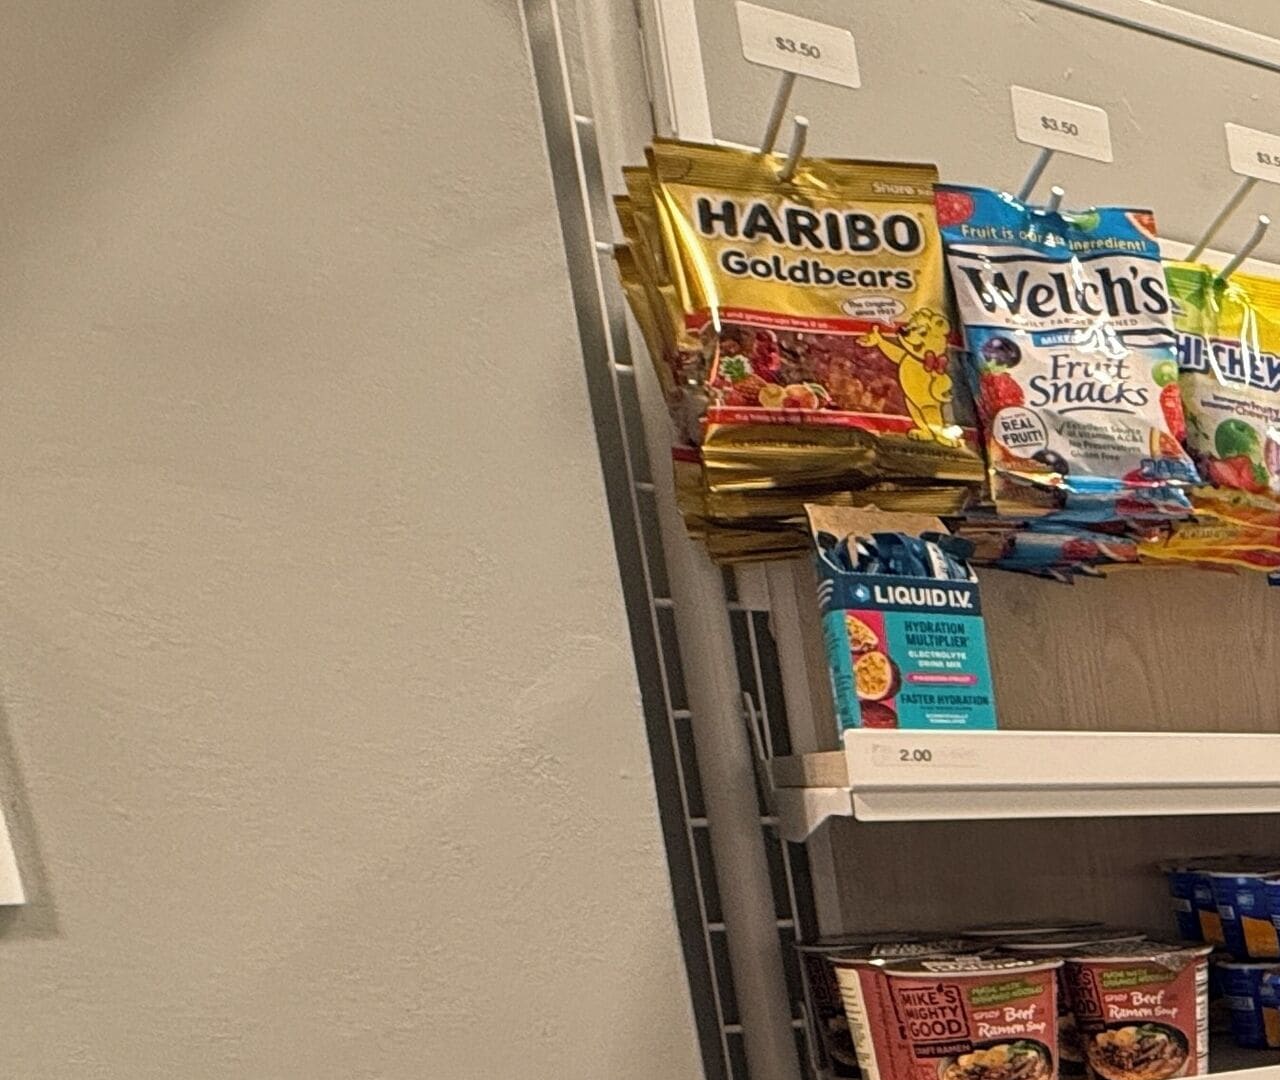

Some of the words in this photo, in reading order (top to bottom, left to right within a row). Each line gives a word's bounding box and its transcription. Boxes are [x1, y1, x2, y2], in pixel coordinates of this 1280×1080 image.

[775, 36, 820, 59] $3.50
[1041, 116, 1078, 136] $3.50
[697, 198, 922, 253] HARIBO
[961, 224, 997, 239] Fruit
[1002, 226, 1014, 239] is
[721, 250, 913, 290] Goldbears
[958, 265, 1167, 317] Welch's
[1051, 354, 1129, 381] Fruit
[1030, 376, 1148, 407] Snacks
[1001, 418, 1034, 432] REAL
[1002, 430, 1042, 446] FRUIT!
[874, 585, 950, 605] LIQUID
[905, 620, 966, 635] HYDRATION
[906, 634, 968, 648] MULTIPLIER
[900, 694, 935, 705] FASTER
[900, 749, 932, 763] 2.00
[901, 984, 957, 1006] MIKE'S
[1130, 990, 1165, 1006] Beef
[905, 1005, 960, 1021] MIGHTY
[1003, 1003, 1036, 1022] Beef
[1107, 1004, 1153, 1019] Ramen
[911, 1019, 963, 1038] GOOD
[976, 1022, 1025, 1038] Ramen
